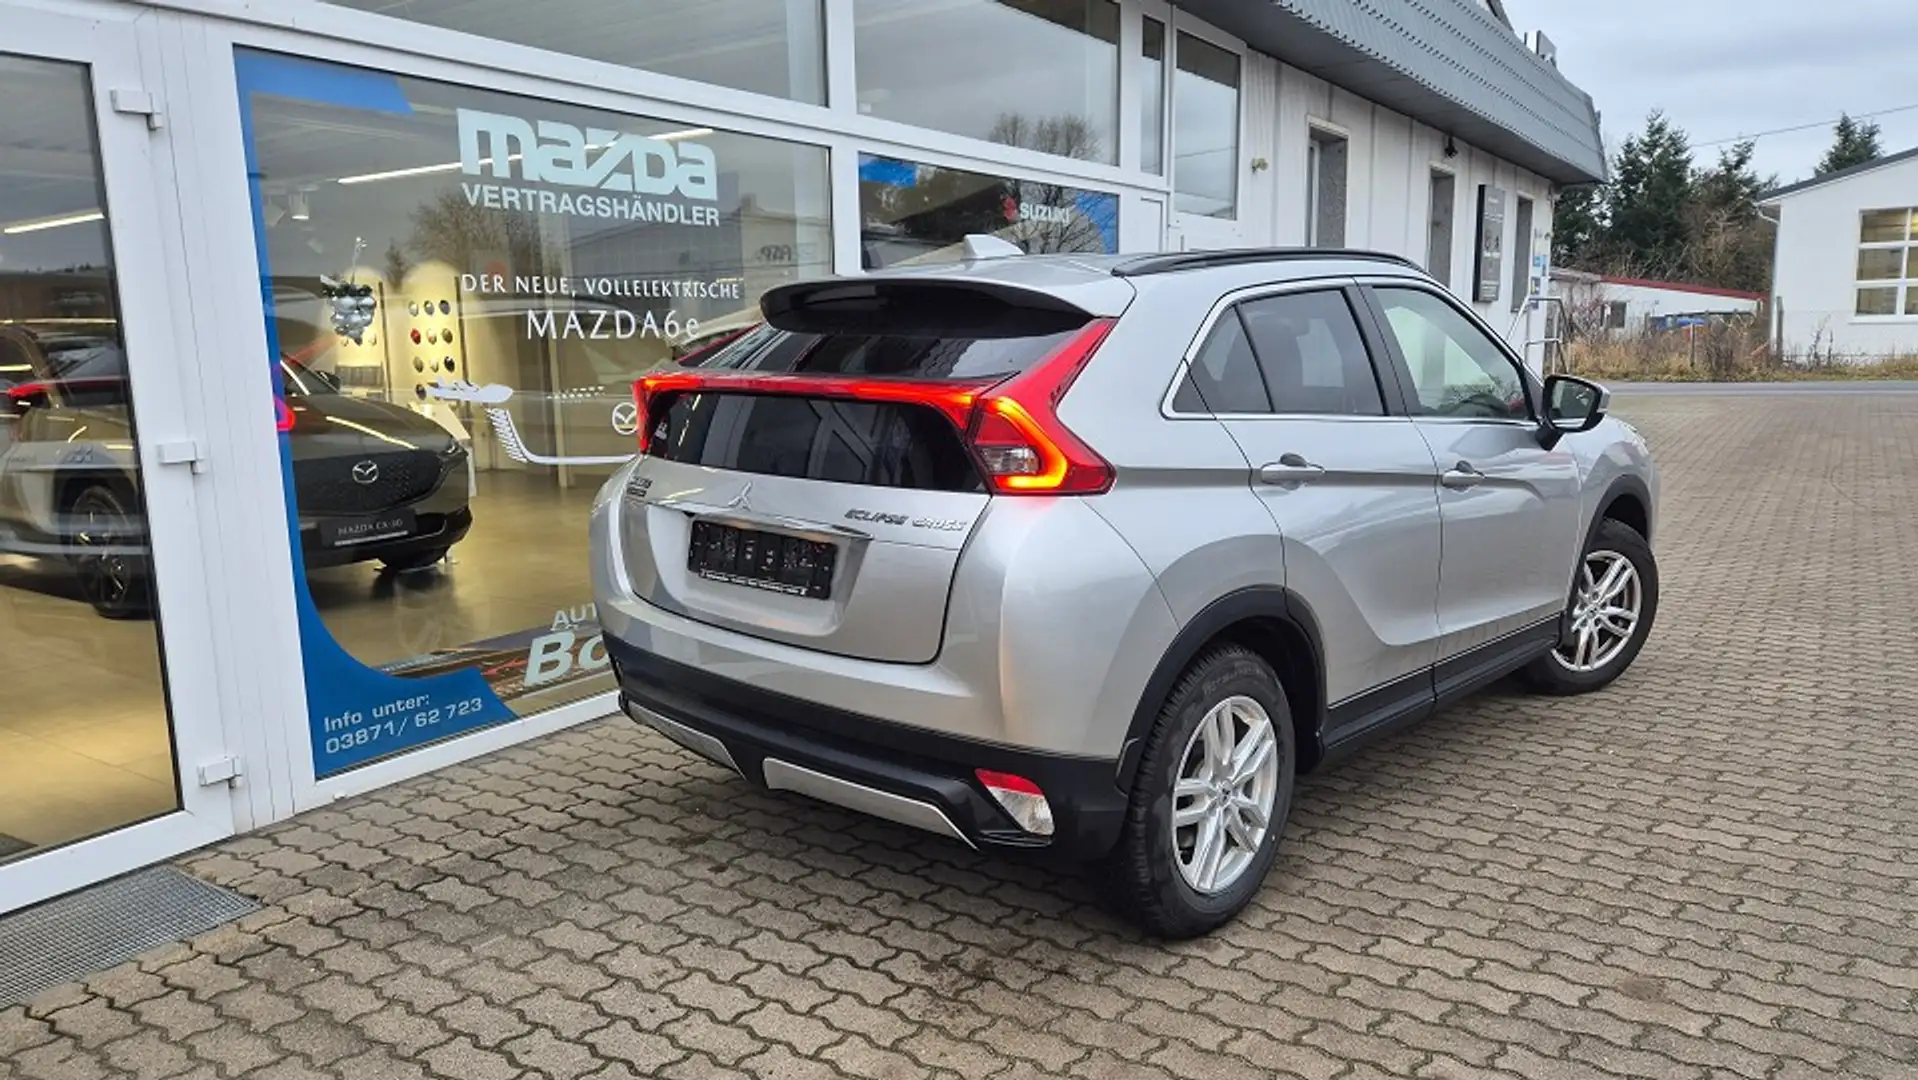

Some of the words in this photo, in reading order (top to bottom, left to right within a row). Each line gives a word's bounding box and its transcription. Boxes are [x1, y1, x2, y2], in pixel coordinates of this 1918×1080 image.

[461, 182, 720, 227] VERTRAGSHÄNDLER
[1020, 202, 1070, 224] SUZUKI
[461, 273, 505, 294] DER
[515, 275, 576, 297] NEUE,
[584, 277, 740, 300] VOLLELEKTRISCHE
[527, 308, 700, 340] MAZDA6e
[844, 508, 909, 525] ECLIPSE
[912, 517, 967, 532] CROSS
[324, 711, 363, 733] Info
[372, 692, 430, 719] unter:
[325, 715, 409, 754] 03871/
[414, 708, 441, 729] 62
[446, 697, 483, 720] 723
